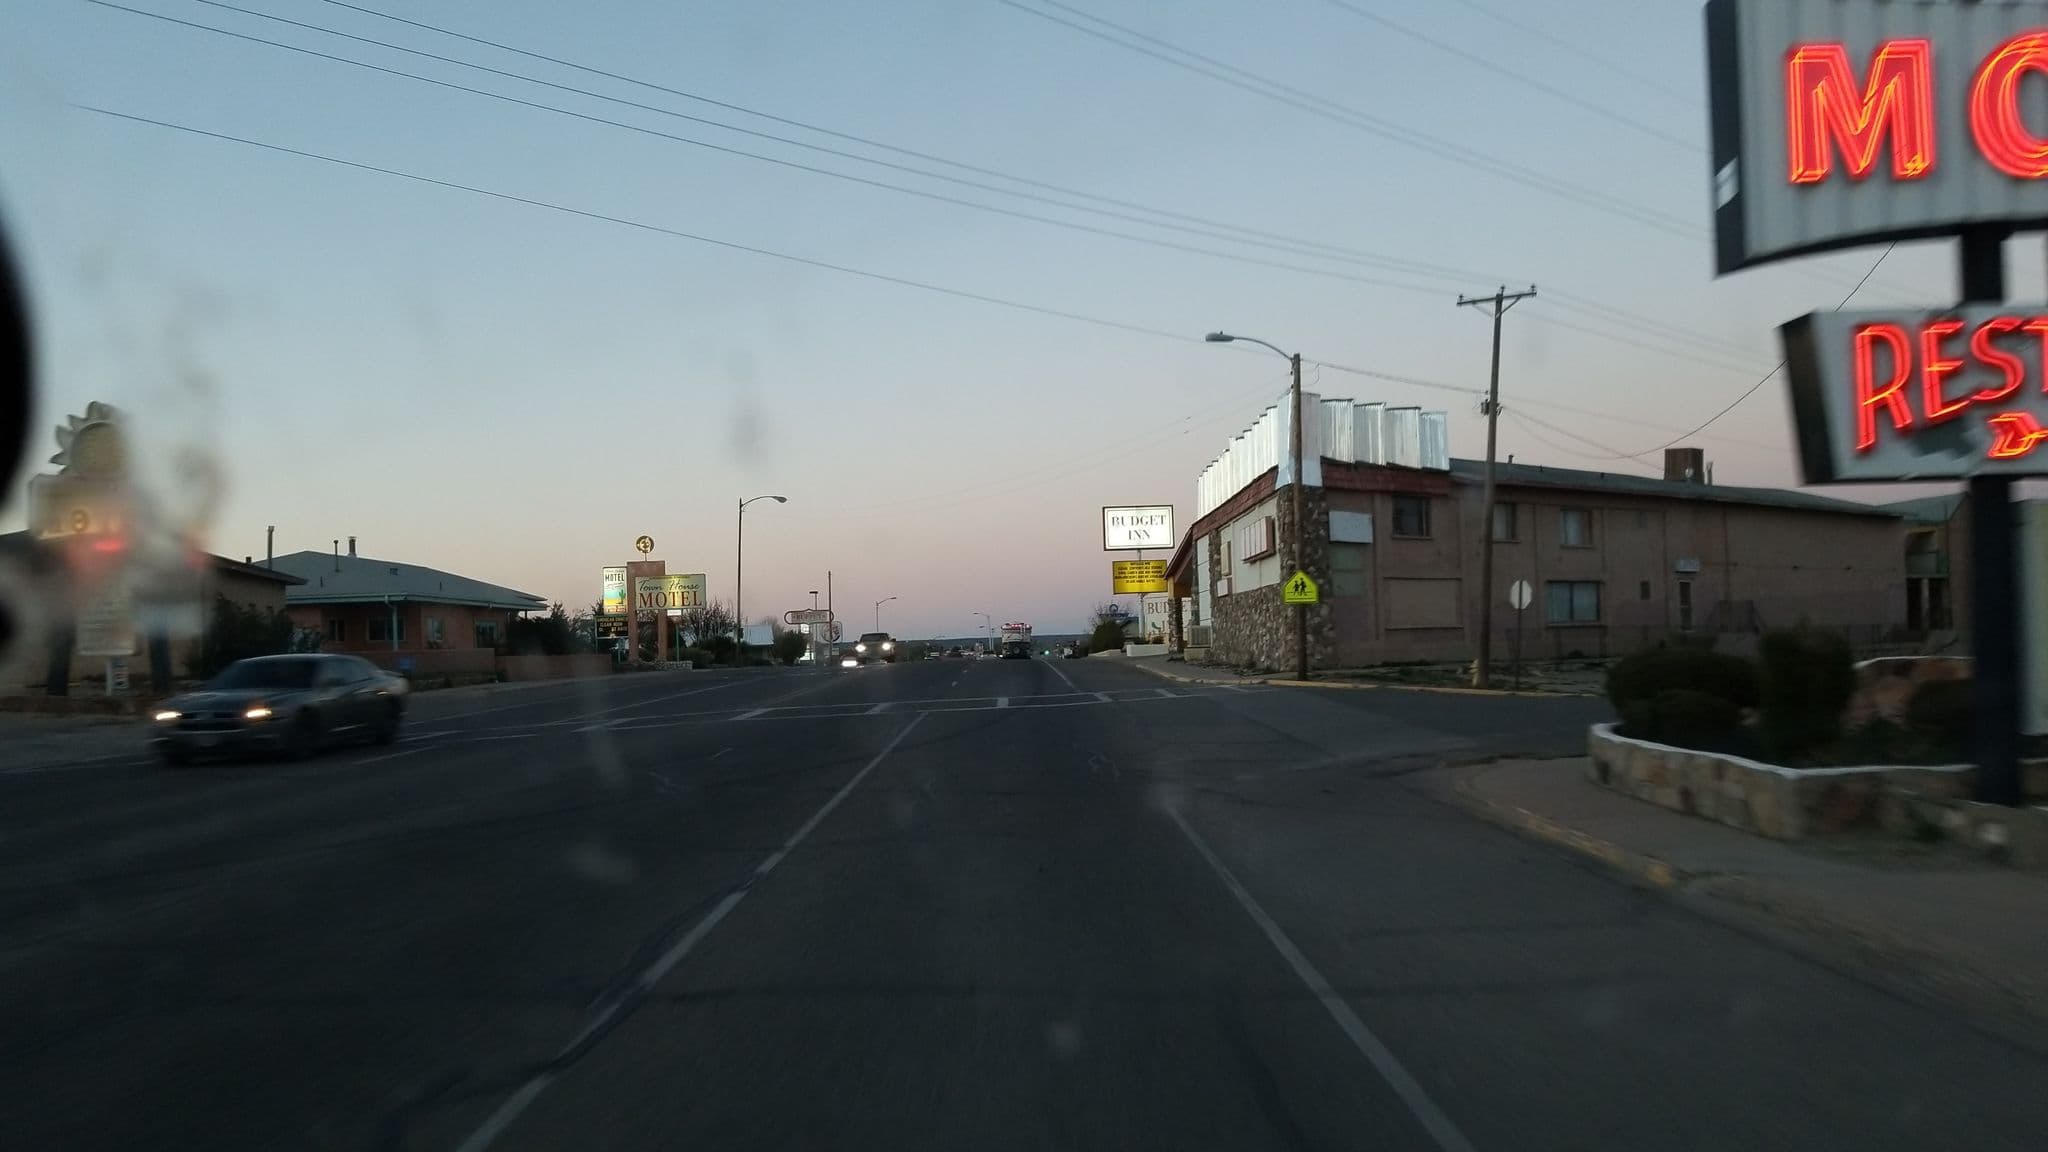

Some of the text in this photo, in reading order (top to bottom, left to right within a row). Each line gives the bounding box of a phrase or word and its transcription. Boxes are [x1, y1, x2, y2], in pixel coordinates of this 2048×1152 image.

[1111, 514, 1166, 527] BUDGET
[1128, 529, 1150, 540] INN
[605, 573, 625, 582] MOTEL
[638, 578, 701, 591] Town House
[639, 591, 702, 608] MOTEL
